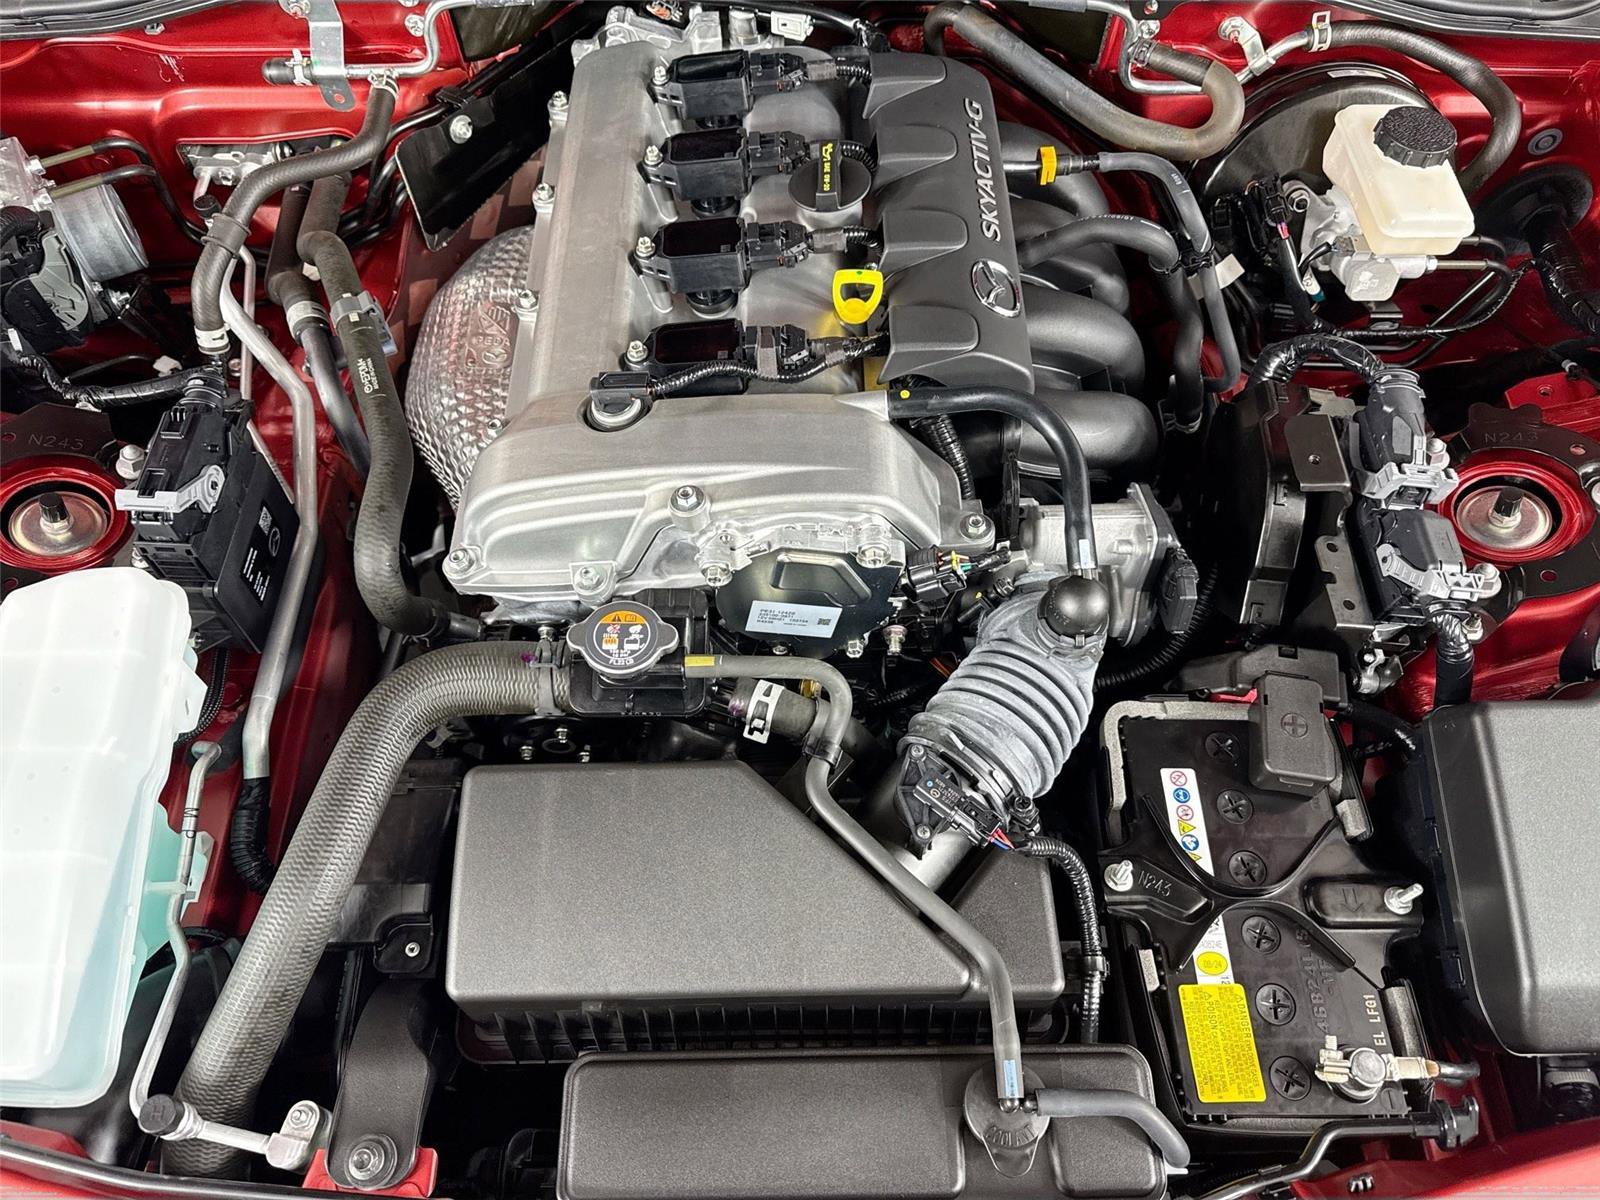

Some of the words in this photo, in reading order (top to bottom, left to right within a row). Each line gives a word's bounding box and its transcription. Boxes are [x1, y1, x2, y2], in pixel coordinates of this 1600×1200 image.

[963, 97, 1001, 242] SKYACTIV-G
[28, 433, 84, 450] N243
[1484, 431, 1538, 445] N243
[1138, 870, 1172, 897] N243
[1205, 1001, 1218, 1029] POISON
[1237, 1003, 1251, 1037] DANGER
[1363, 994, 1380, 1023] LFG1
[1373, 1031, 1387, 1046] EL
